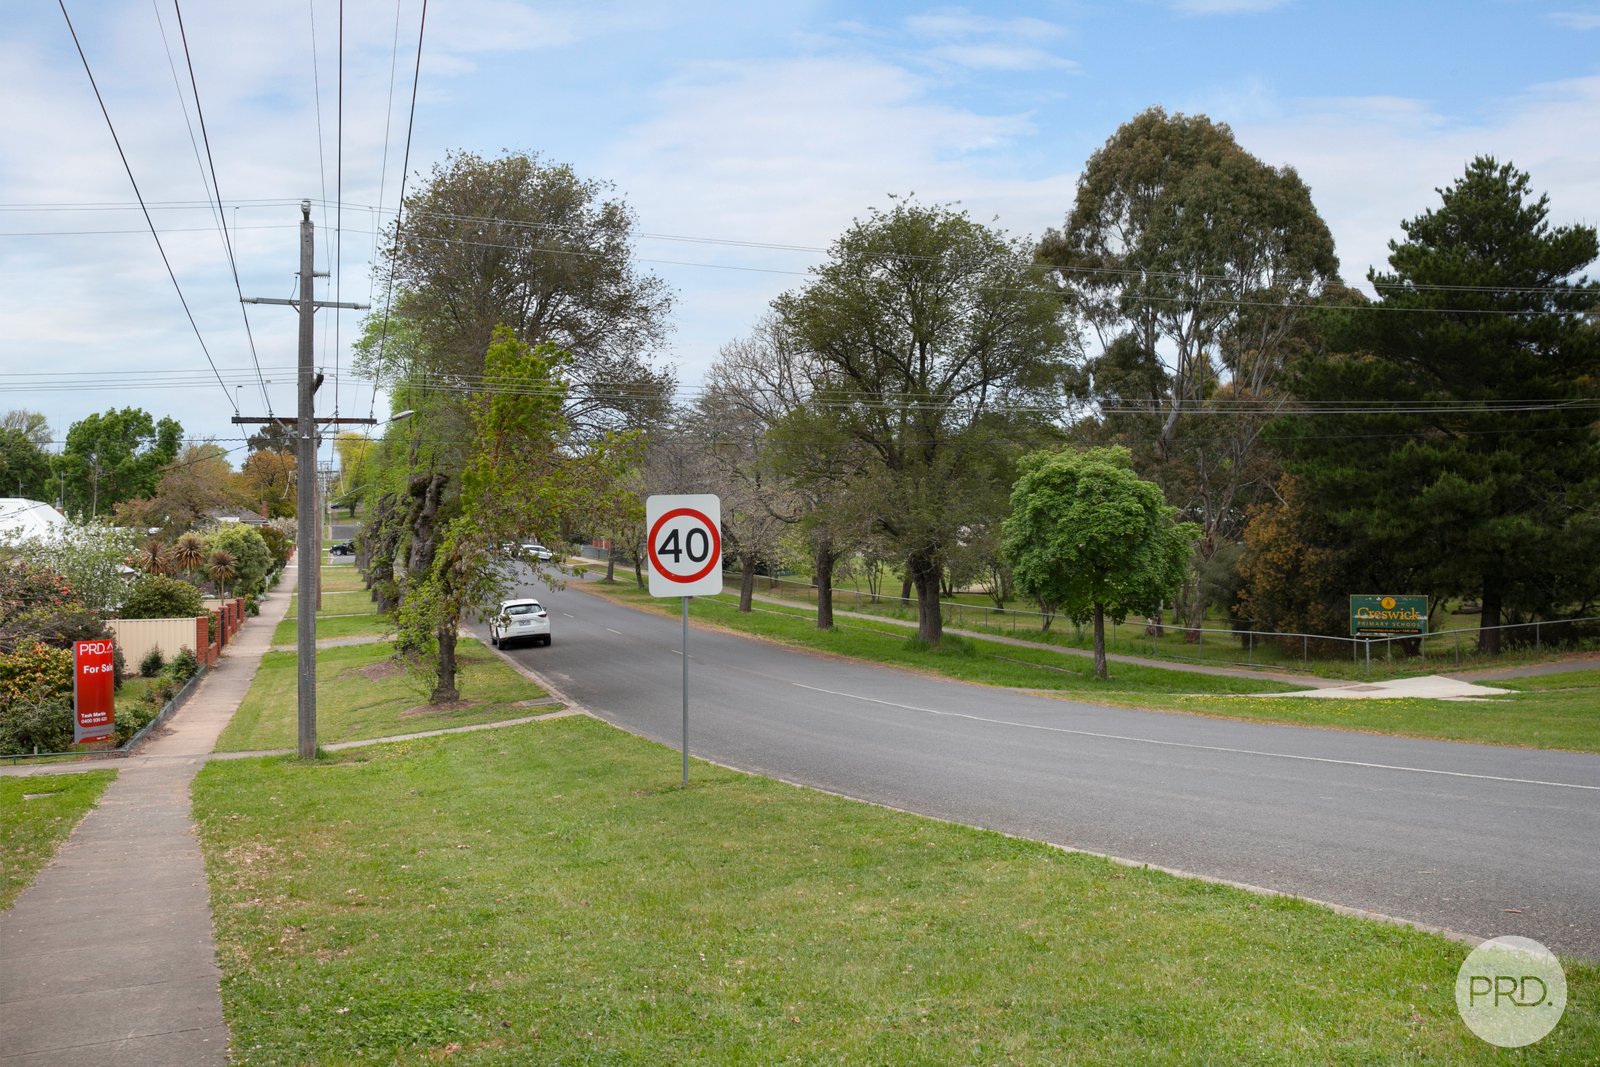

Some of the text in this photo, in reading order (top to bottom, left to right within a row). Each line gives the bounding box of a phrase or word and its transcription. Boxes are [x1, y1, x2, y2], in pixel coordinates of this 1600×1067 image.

[657, 528, 709, 563] 40
[1357, 607, 1420, 620] Creswick
[83, 665, 99, 674] For
